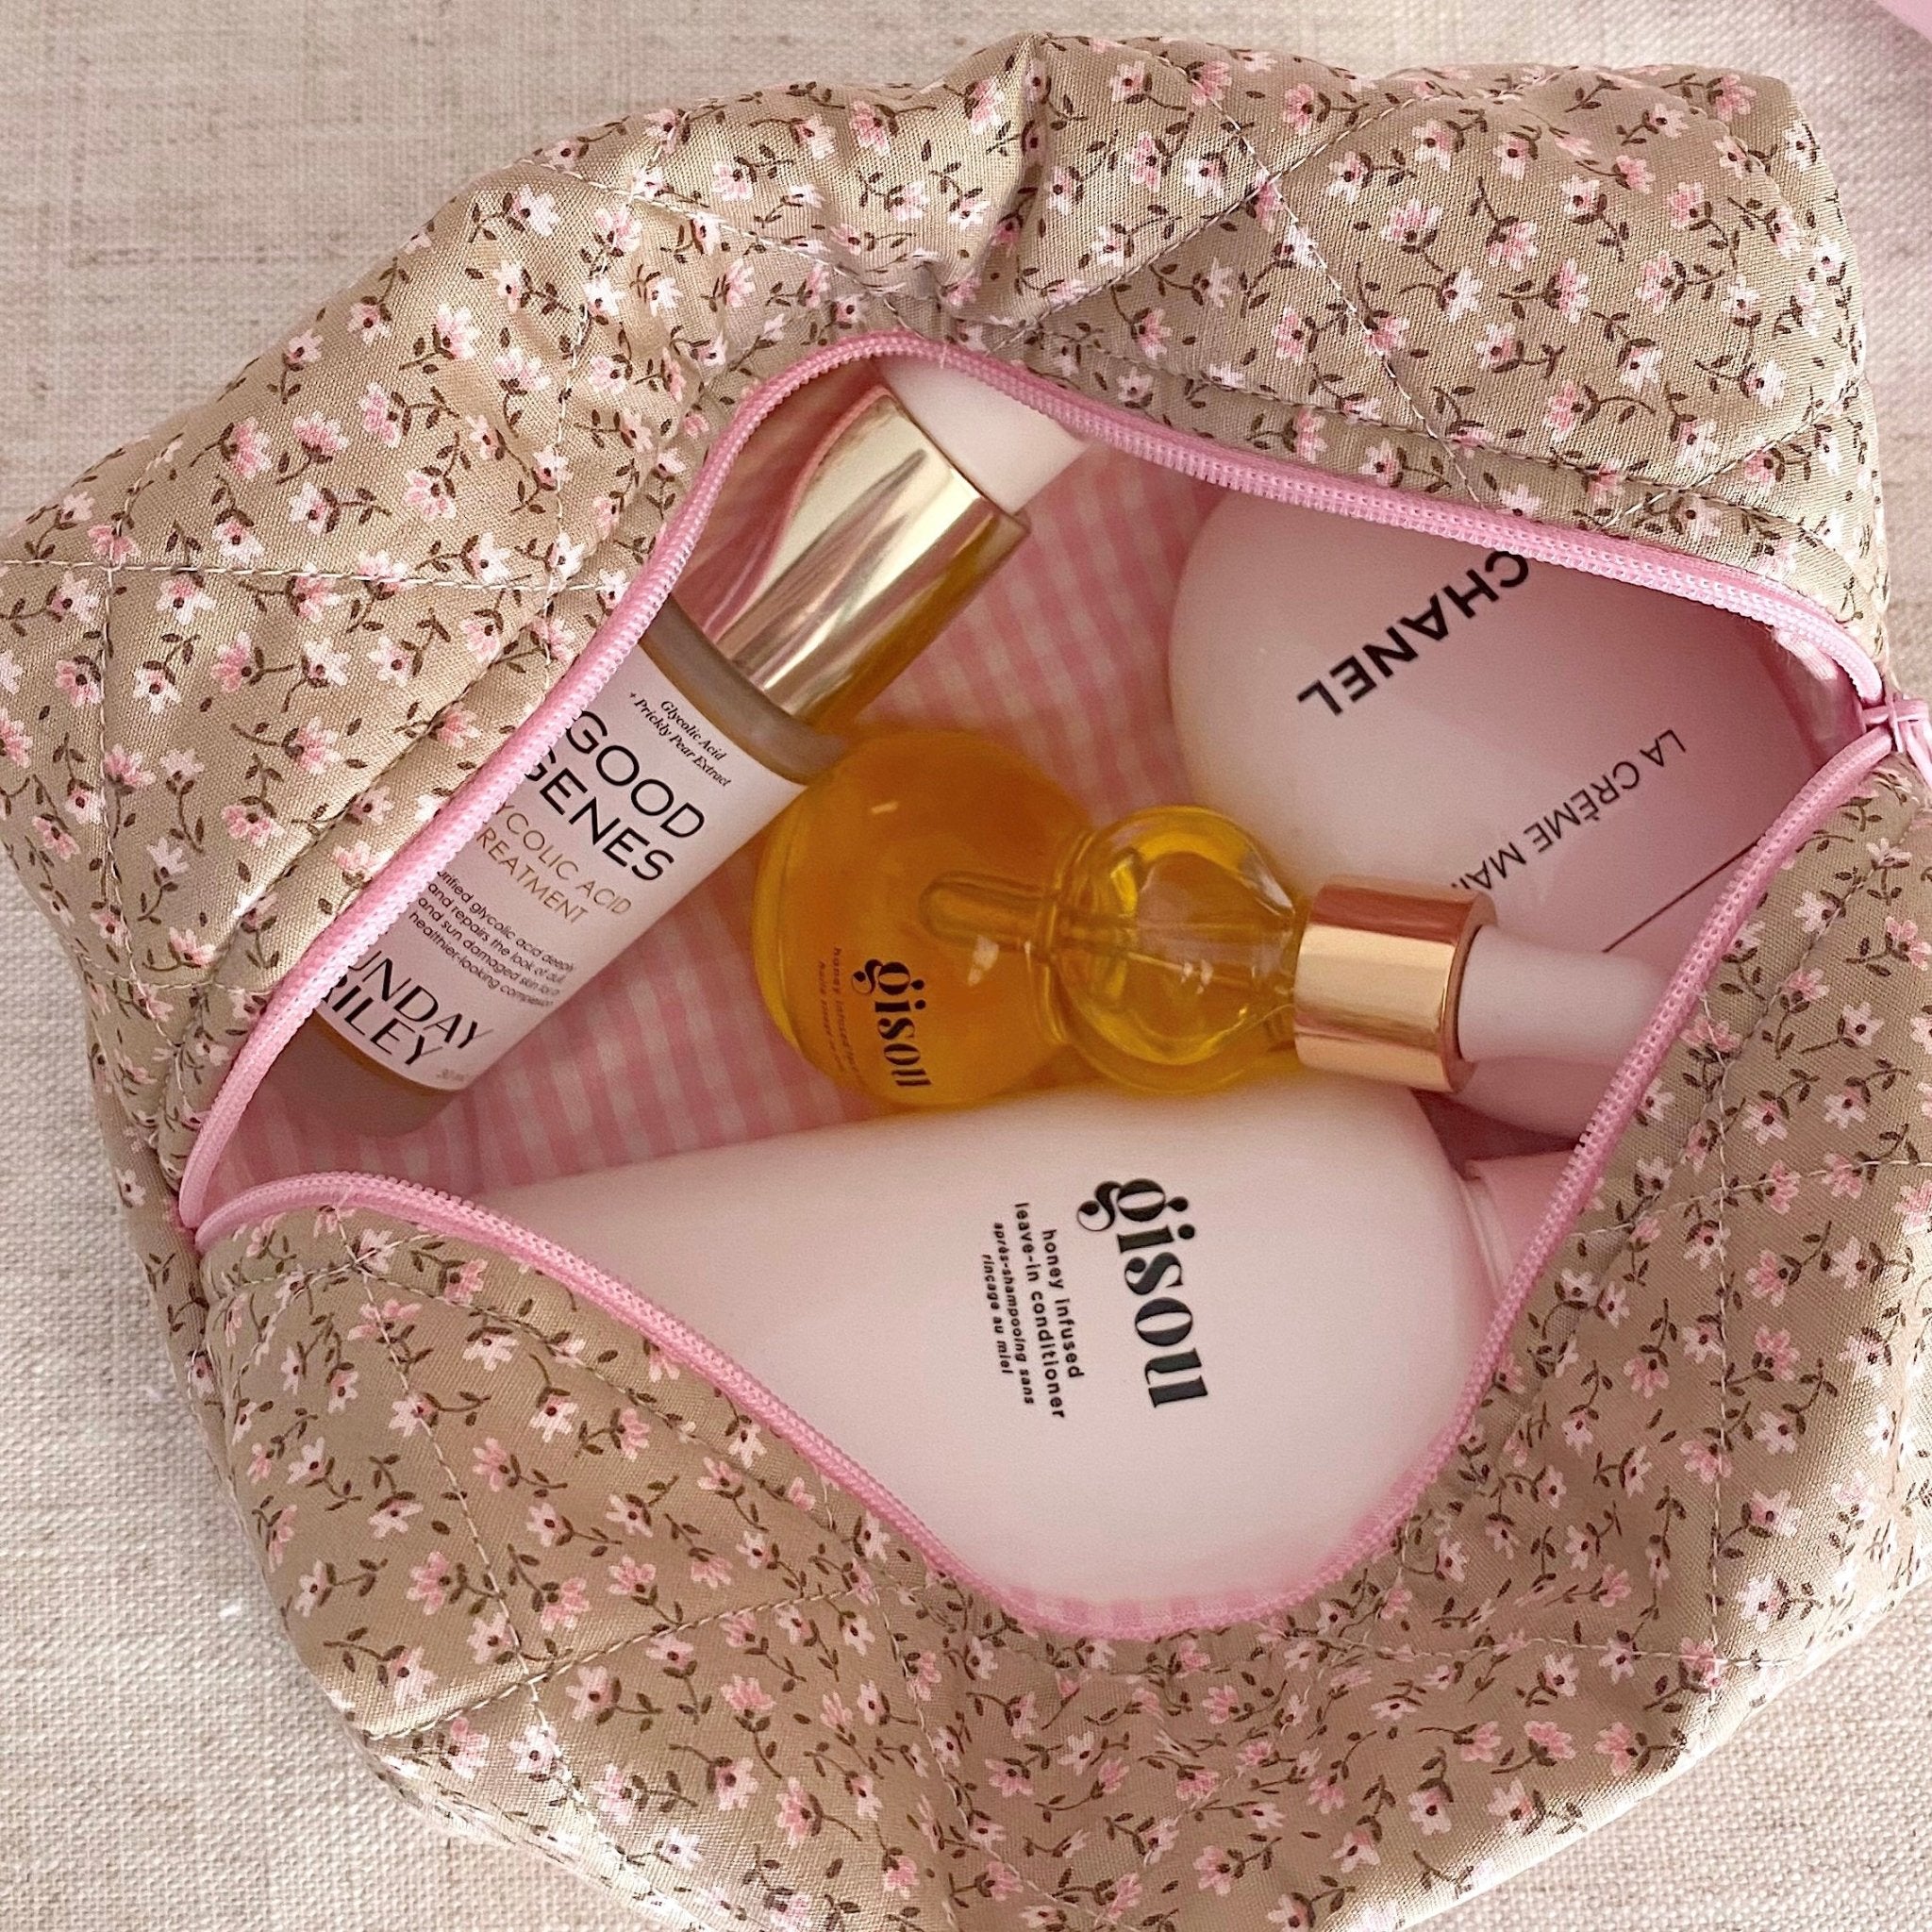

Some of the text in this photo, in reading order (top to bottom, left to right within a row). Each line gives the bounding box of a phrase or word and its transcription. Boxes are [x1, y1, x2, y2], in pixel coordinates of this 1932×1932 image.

[1296, 550, 1529, 716] CHANEL
[566, 710, 705, 838] GOOD
[634, 698, 672, 736] Prickly
[669, 734, 696, 758] Pear
[692, 756, 731, 787] Extract
[660, 700, 727, 760] Glycolic Acid
[1640, 729, 1687, 768] LA
[1524, 760, 1641, 853] CRÈME
[476, 826, 588, 924] REATMENT
[495, 802, 631, 915] YCOLIC ACID
[409, 910, 500, 991] healthier-looking
[418, 897, 443, 922] and
[441, 920, 462, 941] sun
[463, 939, 520, 980] damaged
[428, 883, 454, 908] and
[451, 906, 491, 941] repairs
[491, 939, 510, 956] the
[510, 953, 533, 971] look
[437, 871, 474, 904] urified
[470, 901, 516, 940] glycolic
[516, 938, 543, 958] acid
[348, 950, 494, 1049] UNDAY
[852, 958, 932, 1086] gisou
[993, 1316, 1005, 1334] au
[1015, 1202, 1065, 1418] leave-in conditioner
[1042, 1229, 1084, 1378] honey infused
[1076, 1178, 1208, 1407] gisou
[996, 1341, 1014, 1374] miel
[1019, 1368, 1035, 1405] sans
